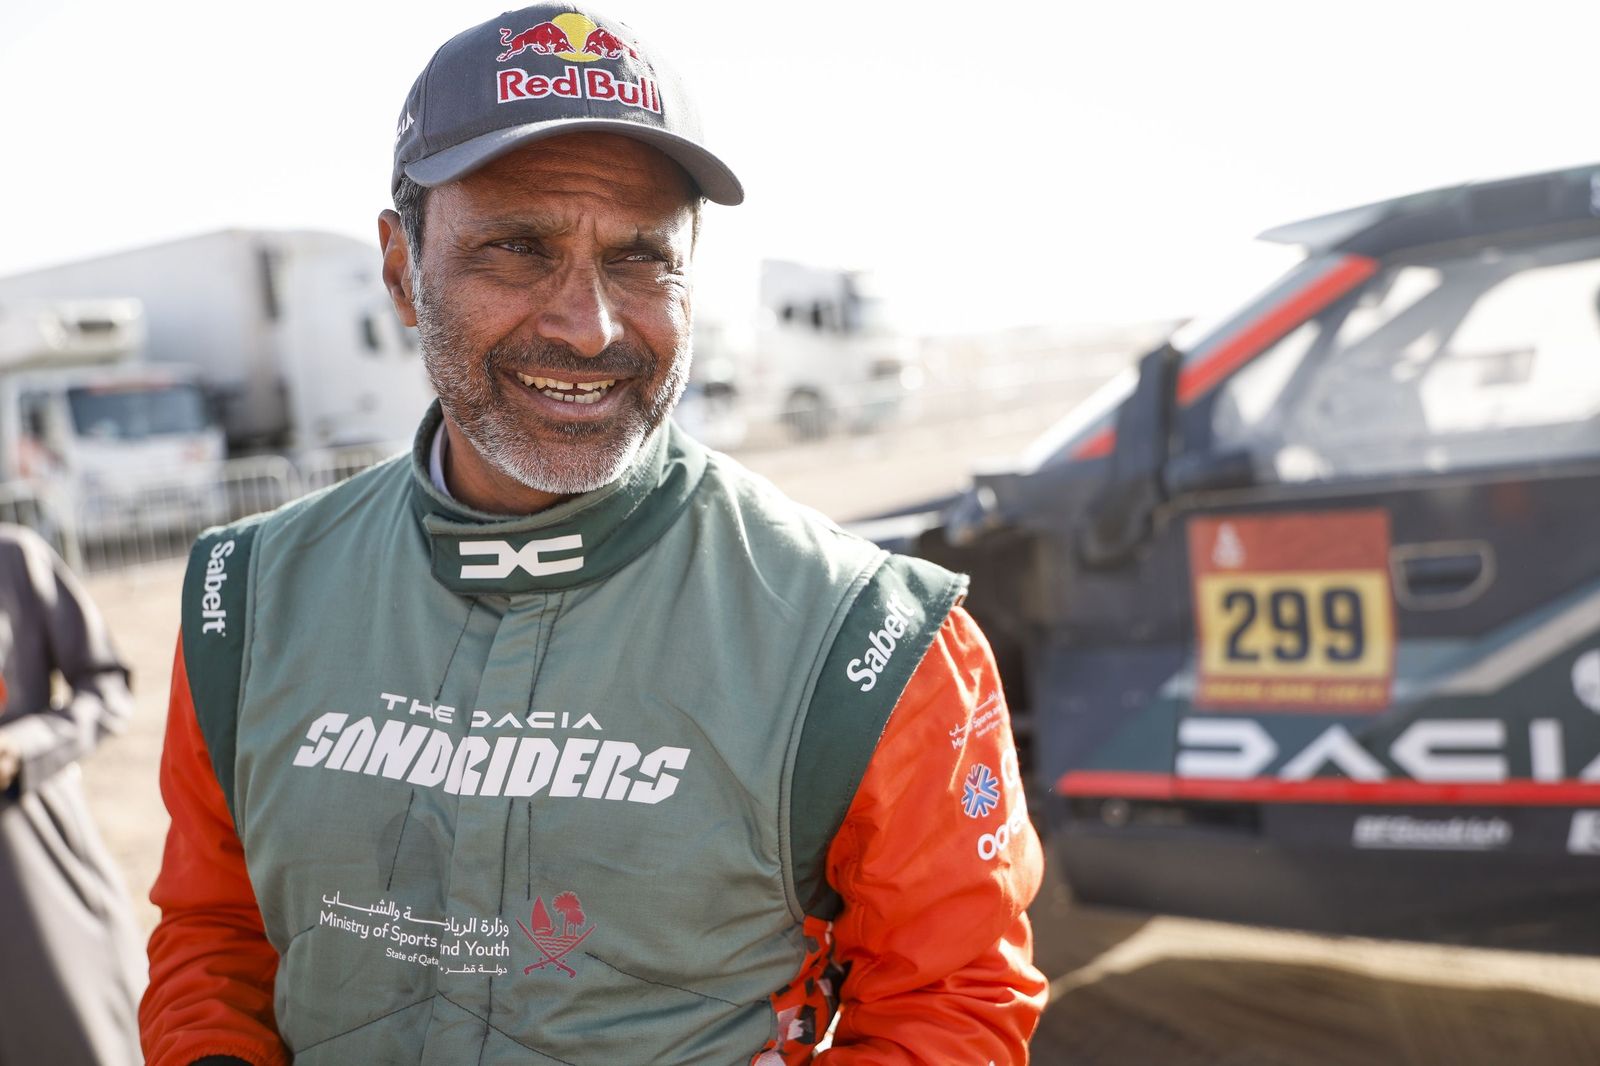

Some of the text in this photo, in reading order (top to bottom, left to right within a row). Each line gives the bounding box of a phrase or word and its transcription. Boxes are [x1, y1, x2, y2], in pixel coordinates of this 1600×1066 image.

[497, 66, 661, 114] Red Bull
[202, 540, 235, 636] Sabelt
[846, 590, 915, 692] Sabelt
[1222, 586, 1366, 663] 299
[380, 693, 603, 731] THE DACIA
[292, 712, 691, 805] SANDRIDERS
[1175, 718, 1600, 782] DACI
[322, 890, 401, 922] والشباب
[480, 917, 510, 938] وزارة
[319, 910, 370, 939] Ministry
[373, 923, 389, 938] of
[390, 925, 438, 948] Sports
[464, 940, 510, 957] Youth
[386, 947, 439, 967] State of Qata
[445, 963, 508, 977] دولة قطر
